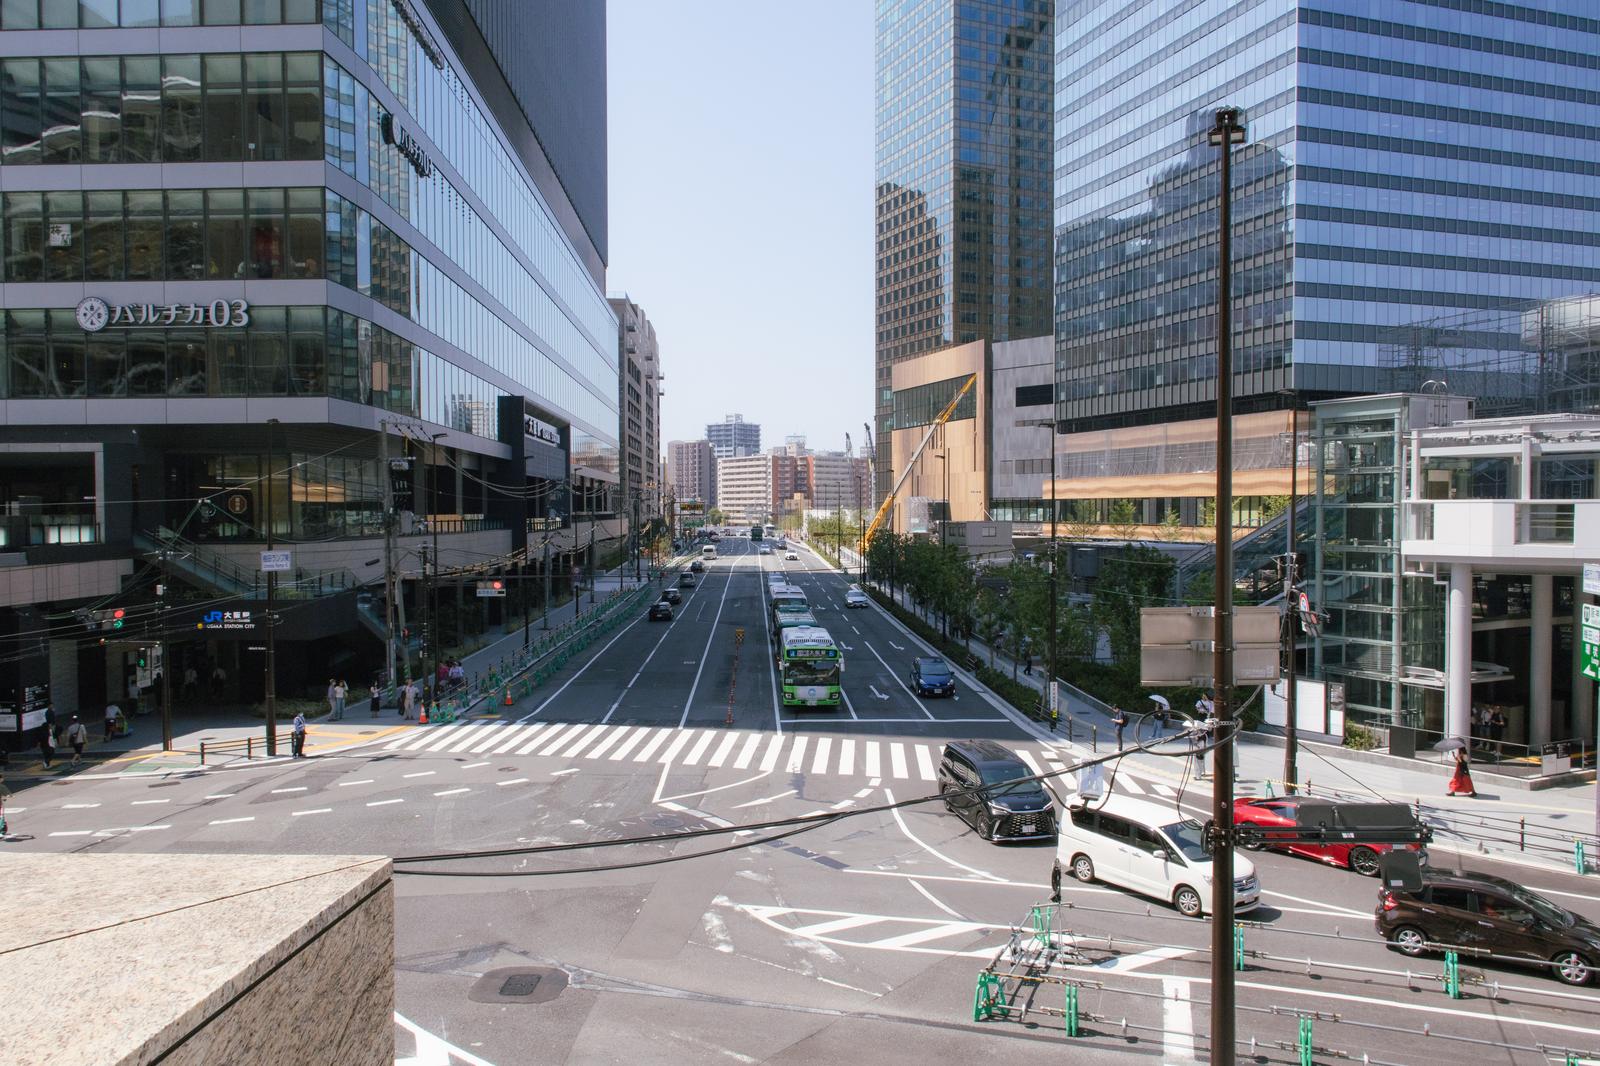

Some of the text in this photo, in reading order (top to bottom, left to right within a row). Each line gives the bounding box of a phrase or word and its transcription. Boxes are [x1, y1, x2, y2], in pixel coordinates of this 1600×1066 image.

[111, 298, 250, 328] バルチカ03
[204, 611, 222, 622] JR
